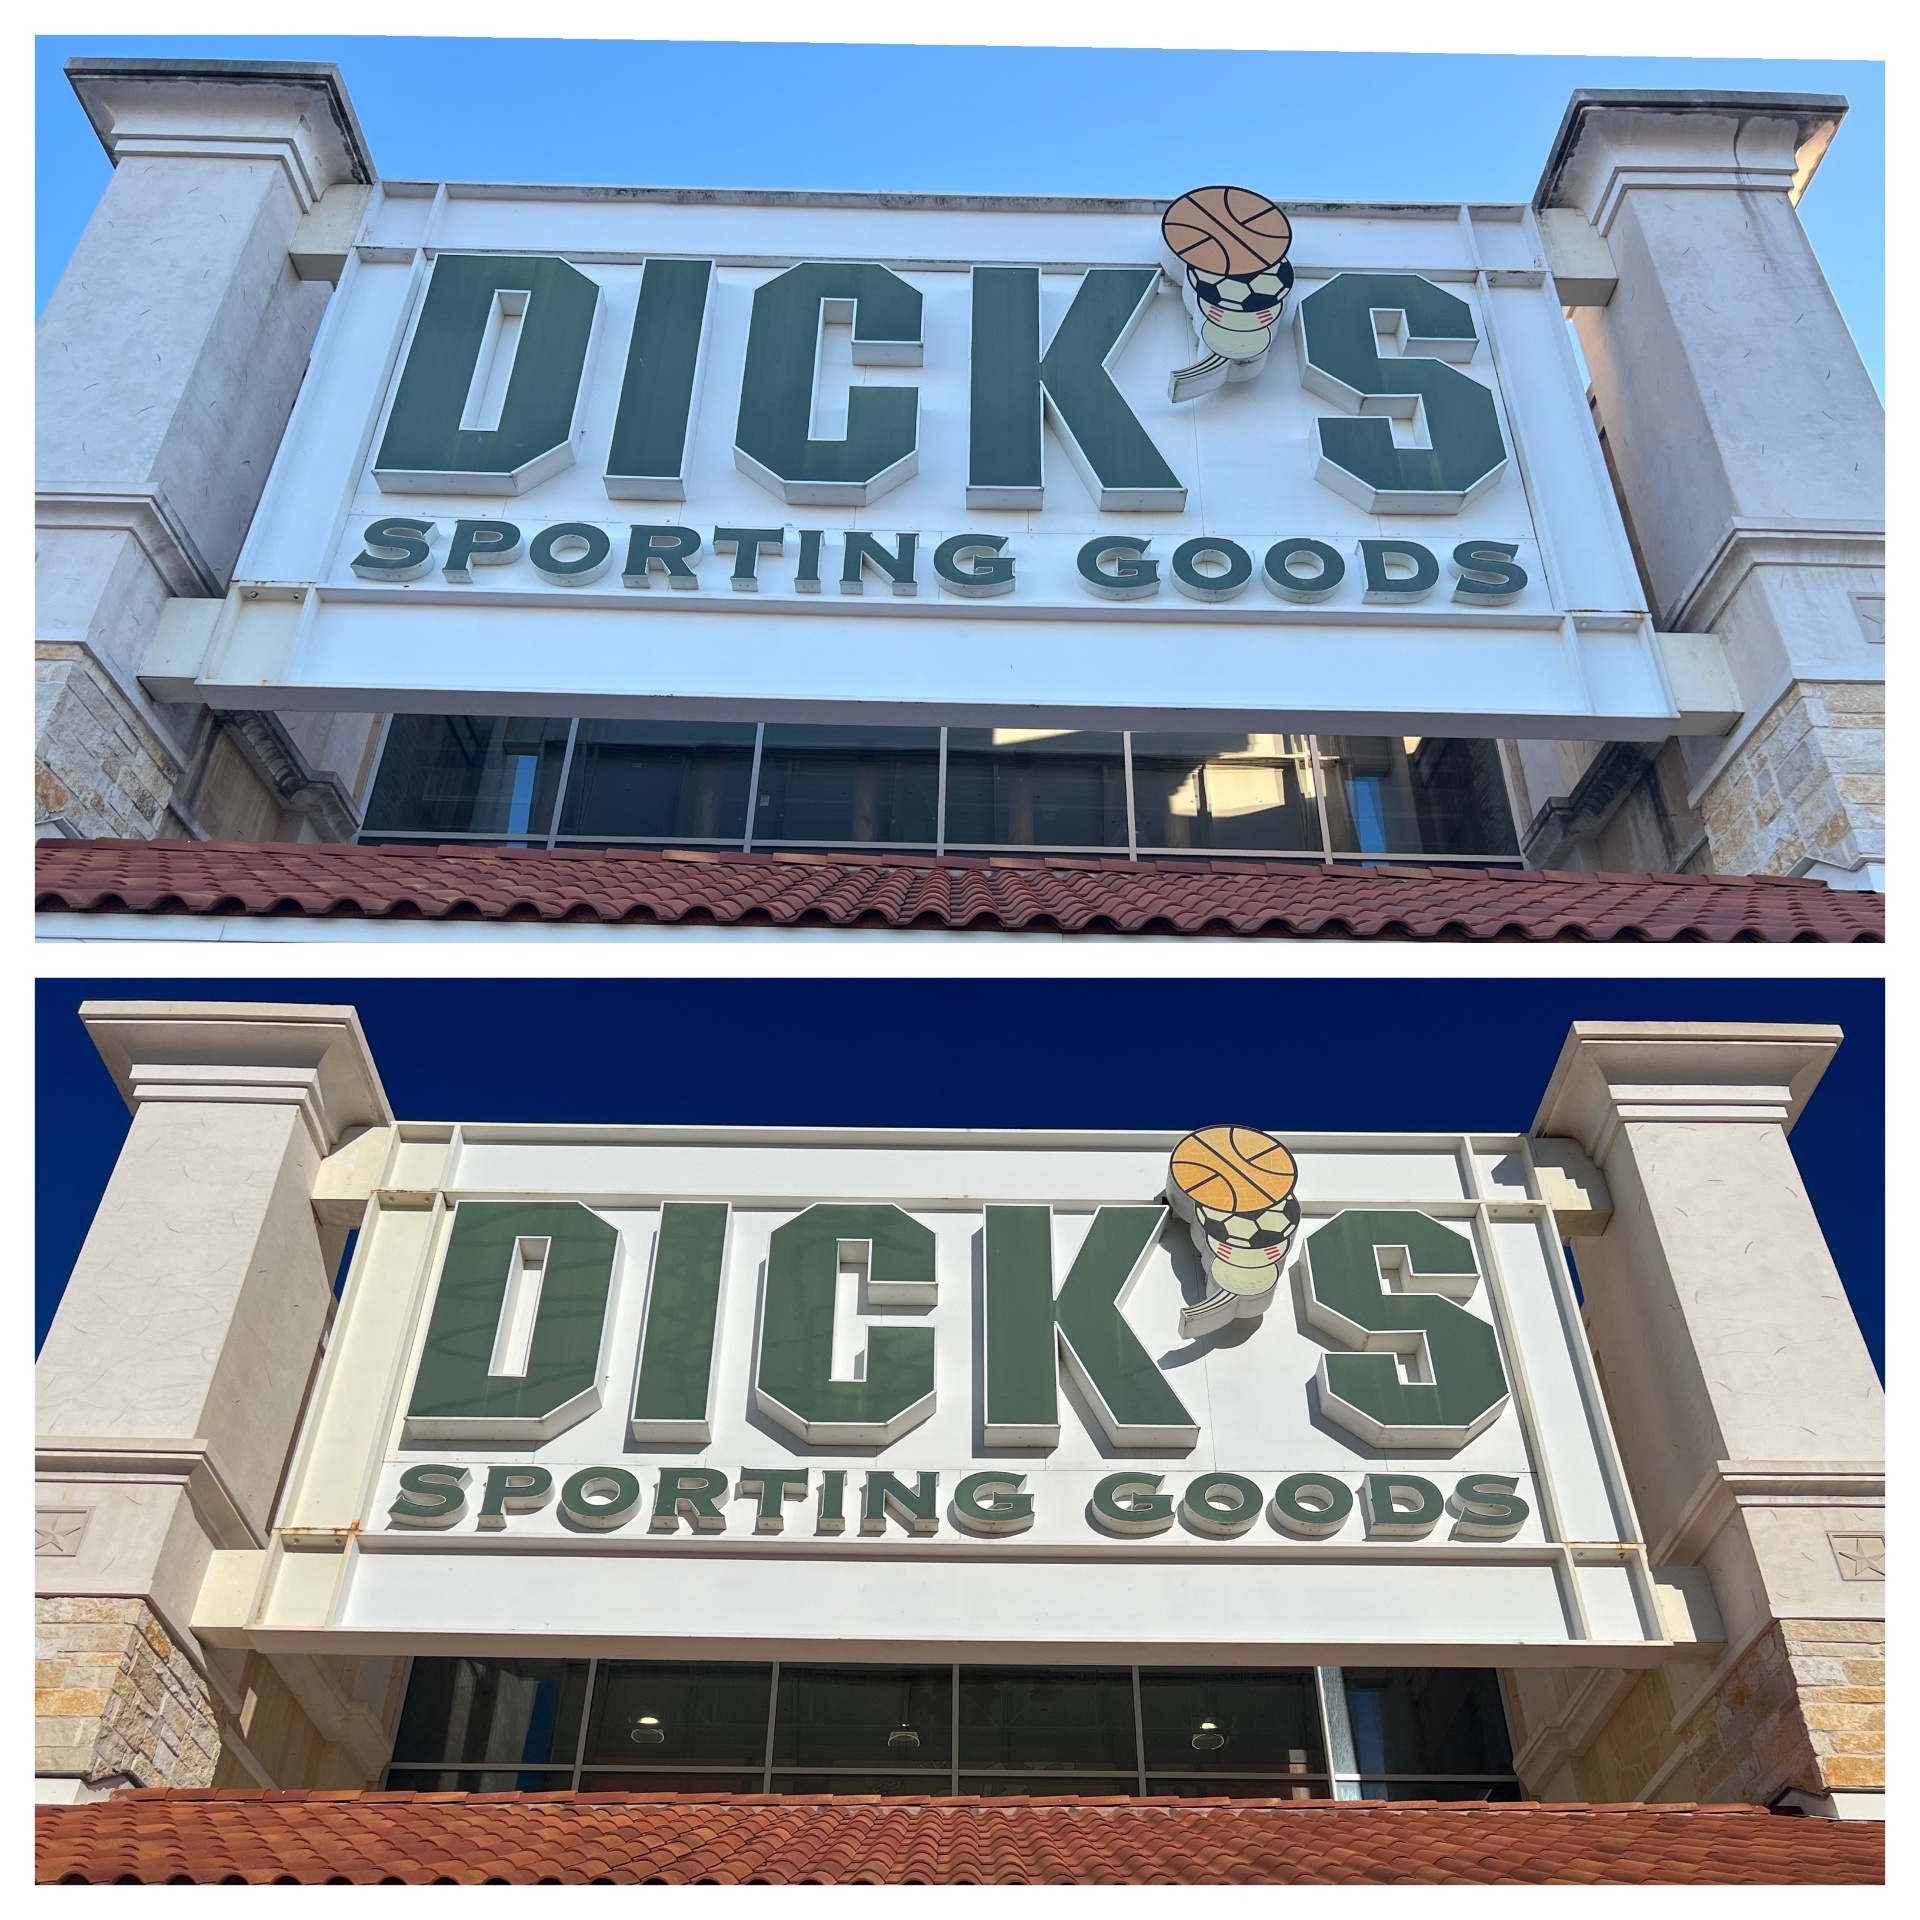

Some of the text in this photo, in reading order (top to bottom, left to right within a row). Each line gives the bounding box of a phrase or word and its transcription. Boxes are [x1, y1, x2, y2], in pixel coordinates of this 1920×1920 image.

[372, 186, 1510, 514] DICK'S
[351, 518, 1529, 605] SPORTING GOODS
[404, 1124, 1511, 1449] DICK'S
[388, 1464, 1530, 1537] SPORTING GOODS
